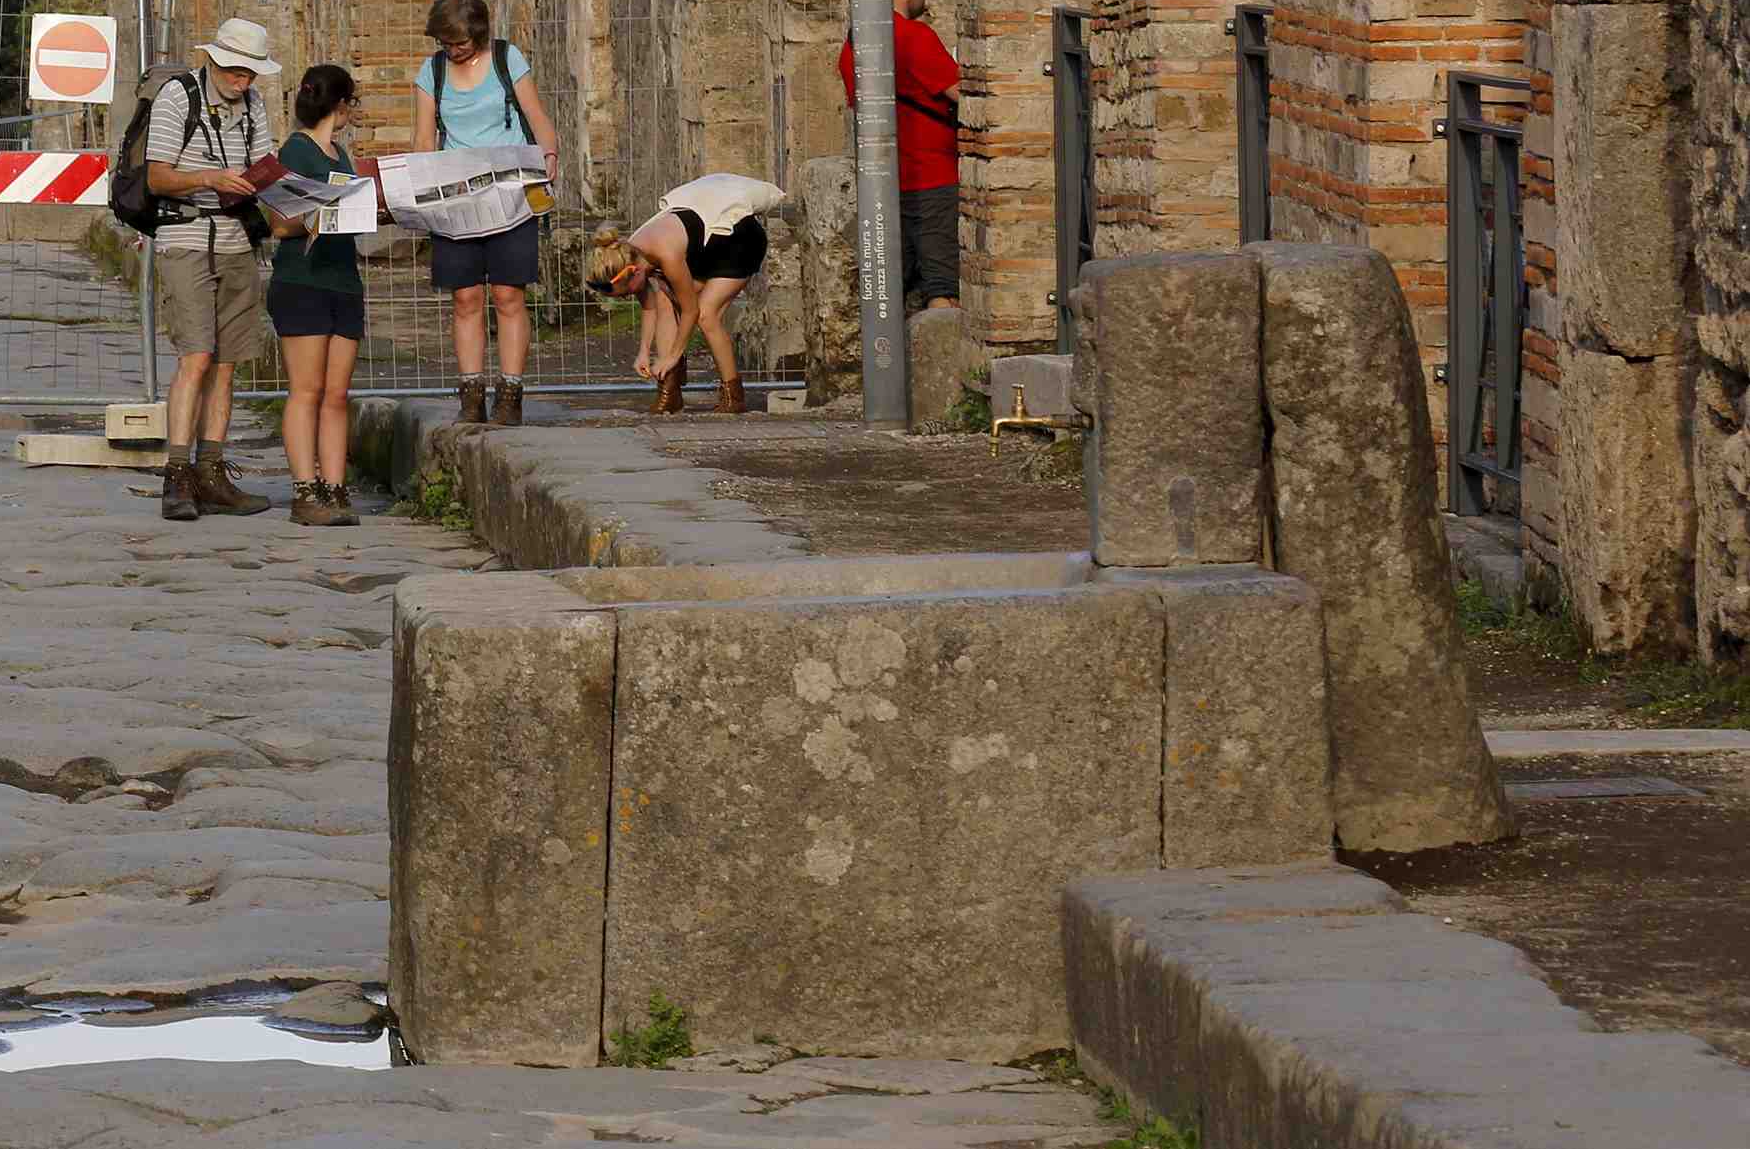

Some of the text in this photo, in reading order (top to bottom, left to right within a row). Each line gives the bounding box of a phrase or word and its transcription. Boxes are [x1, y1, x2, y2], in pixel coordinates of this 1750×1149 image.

[861, 231, 872, 301] fuori le mura
[874, 214, 888, 300] piazza anfiteatro
